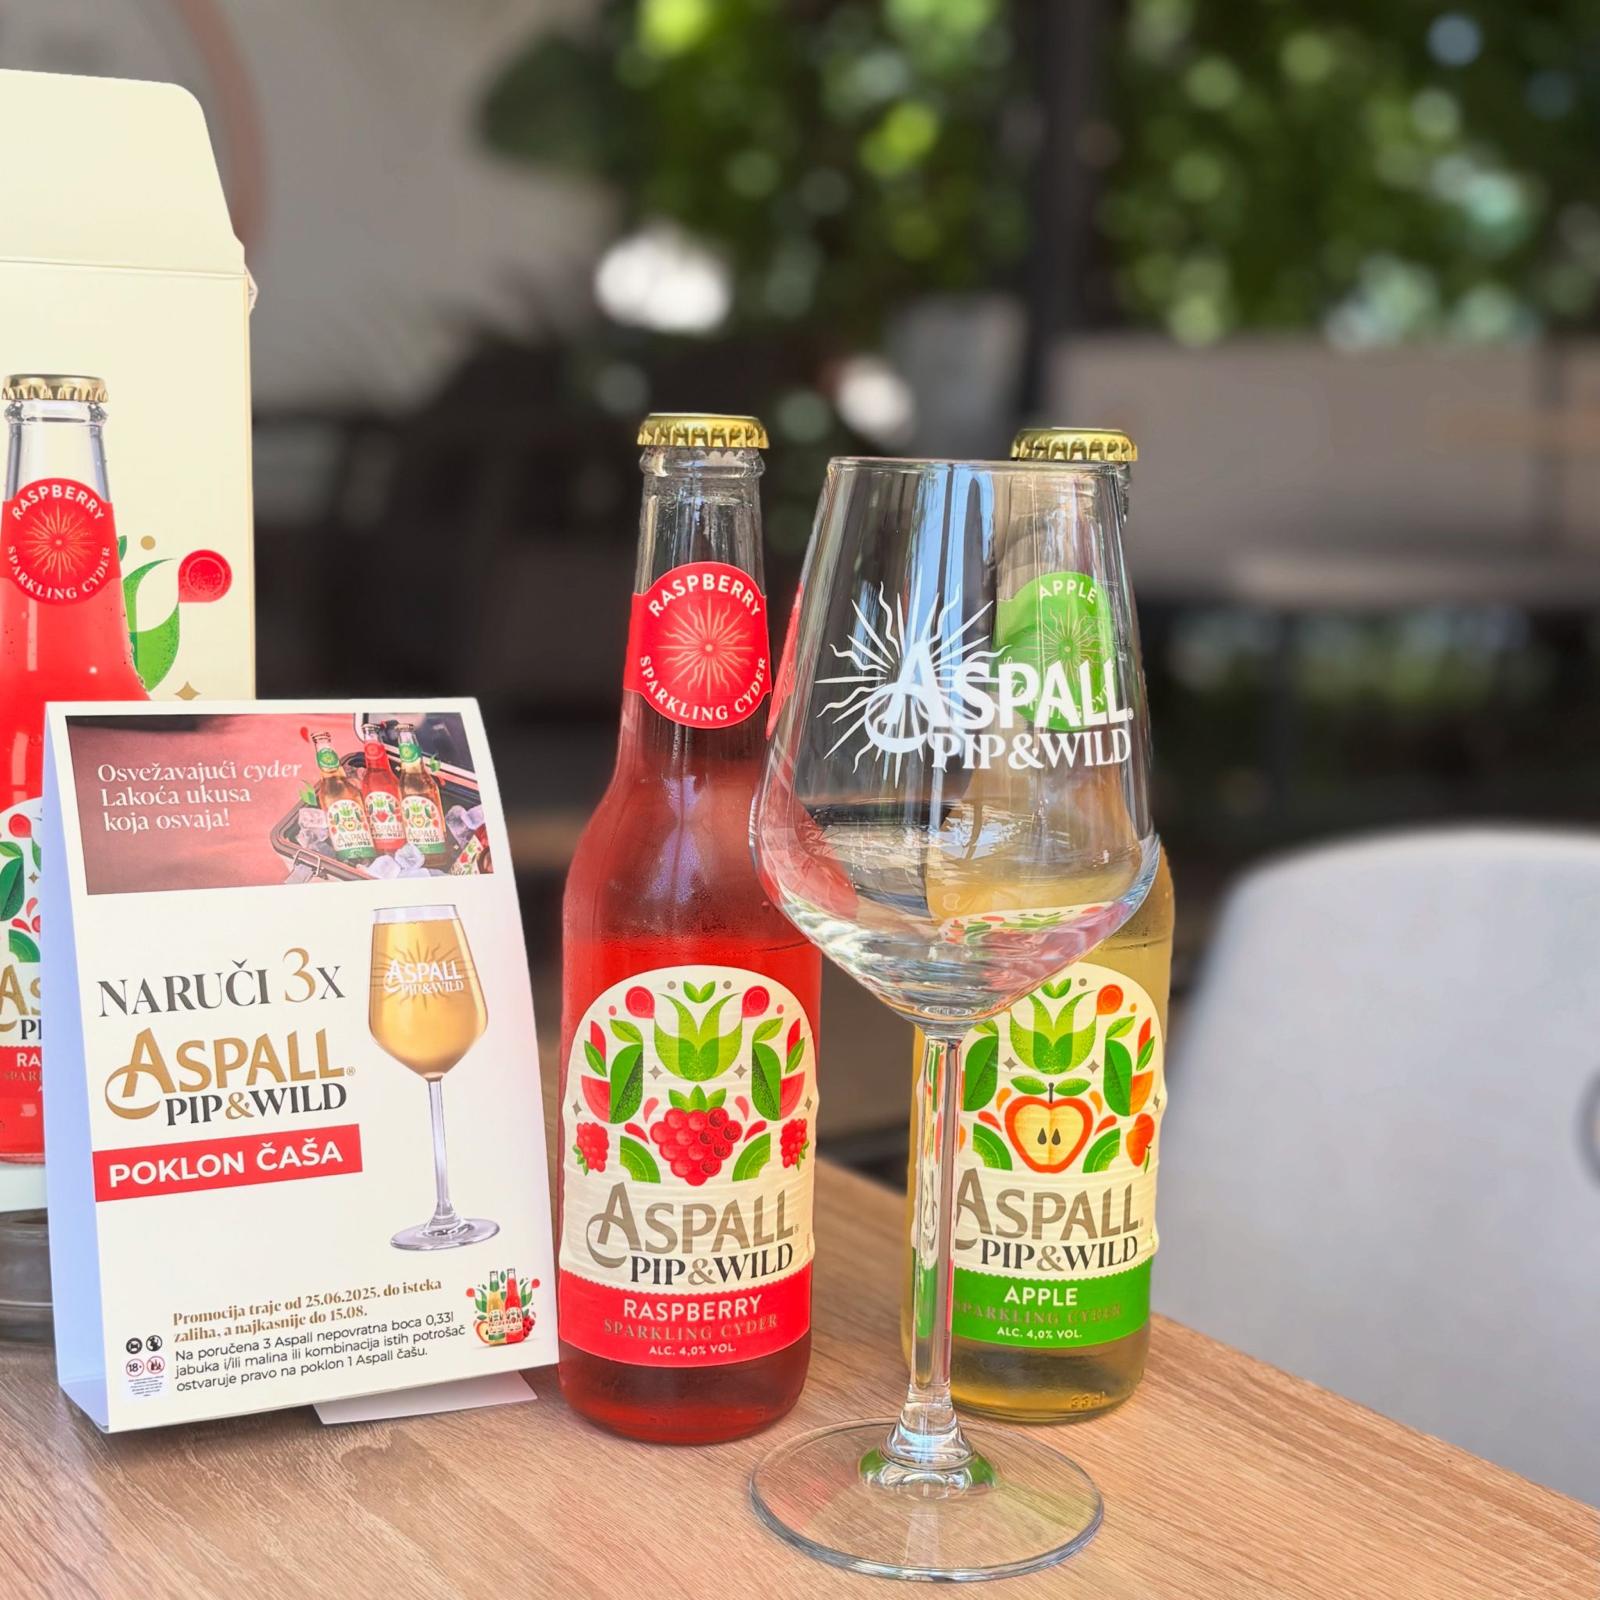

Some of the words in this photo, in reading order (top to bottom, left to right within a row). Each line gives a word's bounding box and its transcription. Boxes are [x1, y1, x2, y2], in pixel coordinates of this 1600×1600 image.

[12, 484, 105, 520] RASPBERRY
[7, 545, 77, 600] SPARKLING
[83, 547, 110, 594] CYDER
[1040, 579, 1097, 604] APPLE
[648, 573, 761, 618] RASPBERRY
[640, 656, 728, 721] SPARKLING
[734, 657, 766, 713] CYDER
[864, 640, 1130, 753] ASPALL
[932, 728, 1131, 770] PIP&WILD
[97, 761, 237, 784] Osvežavajući
[243, 760, 302, 783] cyder
[101, 785, 180, 806] Lakoća
[187, 785, 251, 804] ukusa
[103, 812, 149, 834] koja
[156, 808, 230, 831] osvaja!
[97, 959, 272, 1018] NARUČI
[105, 1027, 346, 1119] ASPALL
[165, 1083, 347, 1126] PIP&WILD
[109, 1151, 244, 1187] POKLON
[256, 1137, 343, 1171] ČAŠA
[586, 1182, 796, 1268] ASPALL
[630, 1243, 793, 1286] PIP&WILD
[981, 1236, 1138, 1272] PIP&WILD
[173, 1305, 246, 1326] Promocija
[249, 1301, 282, 1317] traje
[285, 1296, 301, 1310] od
[305, 1286, 381, 1308] 25.06.2025.
[383, 1284, 400, 1297] do
[403, 1279, 442, 1294] isteka
[623, 1294, 762, 1322] RASPBERRY
[1003, 1285, 1078, 1307] APPLE
[175, 1350, 194, 1362] Na
[198, 1341, 260, 1361] poručena
[263, 1338, 271, 1349] 3
[274, 1332, 313, 1348] Aspall
[317, 1322, 388, 1342] nepovratna
[391, 1318, 422, 1331] boca
[224, 1326, 232, 1336] a
[235, 1314, 306, 1336] najkasnije
[309, 1311, 326, 1324] do
[330, 1304, 368, 1321] 15.08.
[604, 1318, 713, 1341] SPARKLING
[721, 1314, 777, 1337] CYDER
[997, 1327, 1023, 1337] ALC.
[1026, 1329, 1053, 1340] 4,0%
[1056, 1329, 1082, 1339] VOL.
[174, 1362, 220, 1379] jabuka
[224, 1356, 241, 1371] i/ili
[245, 1352, 288, 1367] malina
[292, 1350, 301, 1360] ili
[305, 1338, 380, 1359] kombinacija
[384, 1333, 409, 1347] istih
[413, 1325, 466, 1343] potrošač
[176, 1375, 237, 1392] ostvaruje
[241, 1369, 278, 1385] pravo
[281, 1366, 296, 1377] na
[300, 1358, 344, 1376] poklon
[347, 1356, 353, 1367] 1
[355, 1351, 393, 1366] Aspall
[397, 1346, 428, 1360] čašu.
[649, 1346, 675, 1355] ALC.
[710, 1344, 736, 1353] VOL.
